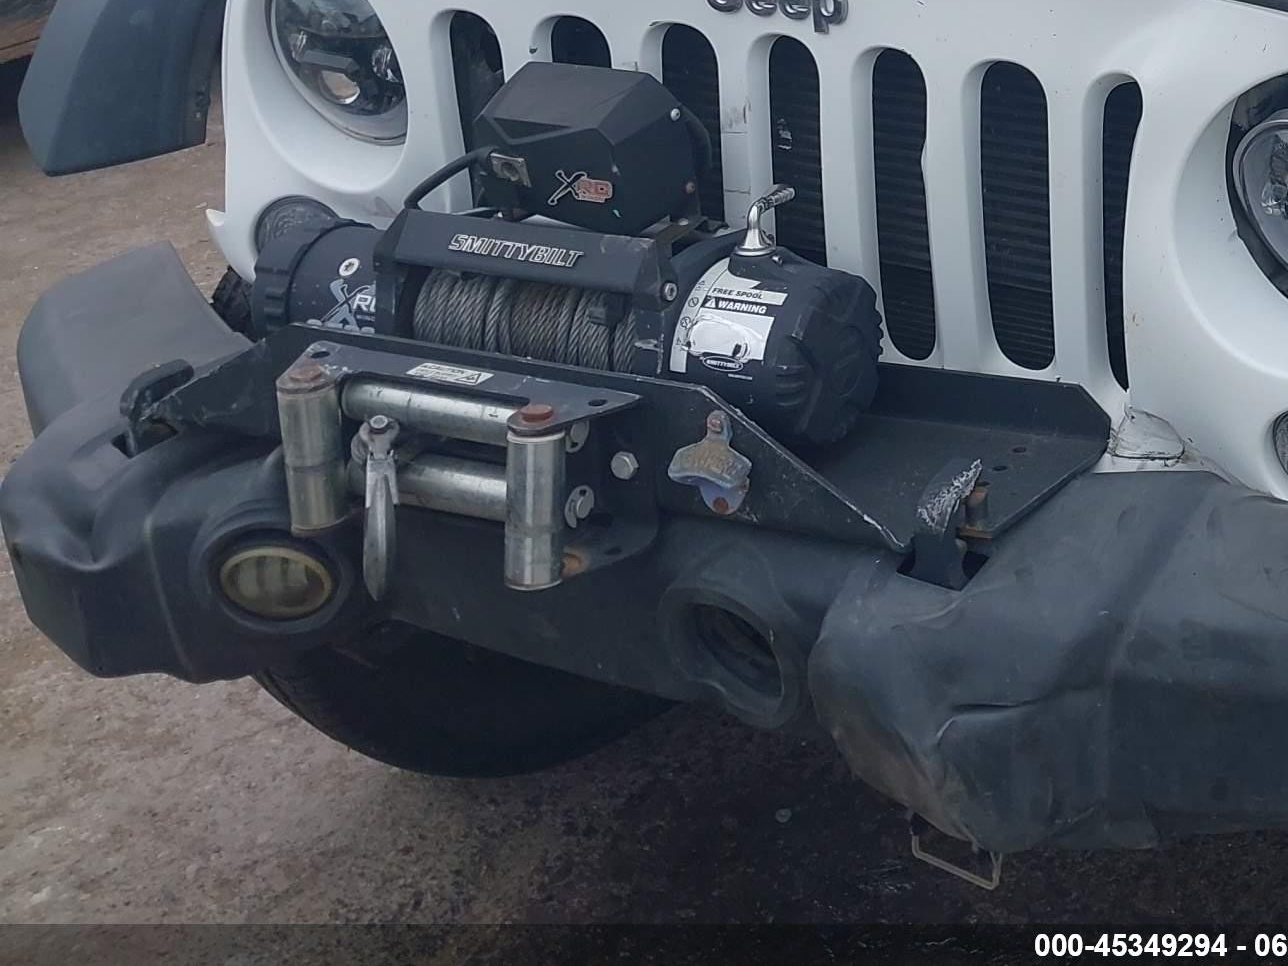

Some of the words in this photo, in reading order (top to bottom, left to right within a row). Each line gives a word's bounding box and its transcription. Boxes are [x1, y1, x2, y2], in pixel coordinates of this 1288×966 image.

[448, 233, 585, 268] SMITTYBILT
[711, 287, 734, 296] FREE
[735, 290, 764, 300] SPOOL
[717, 299, 768, 315] WARNING
